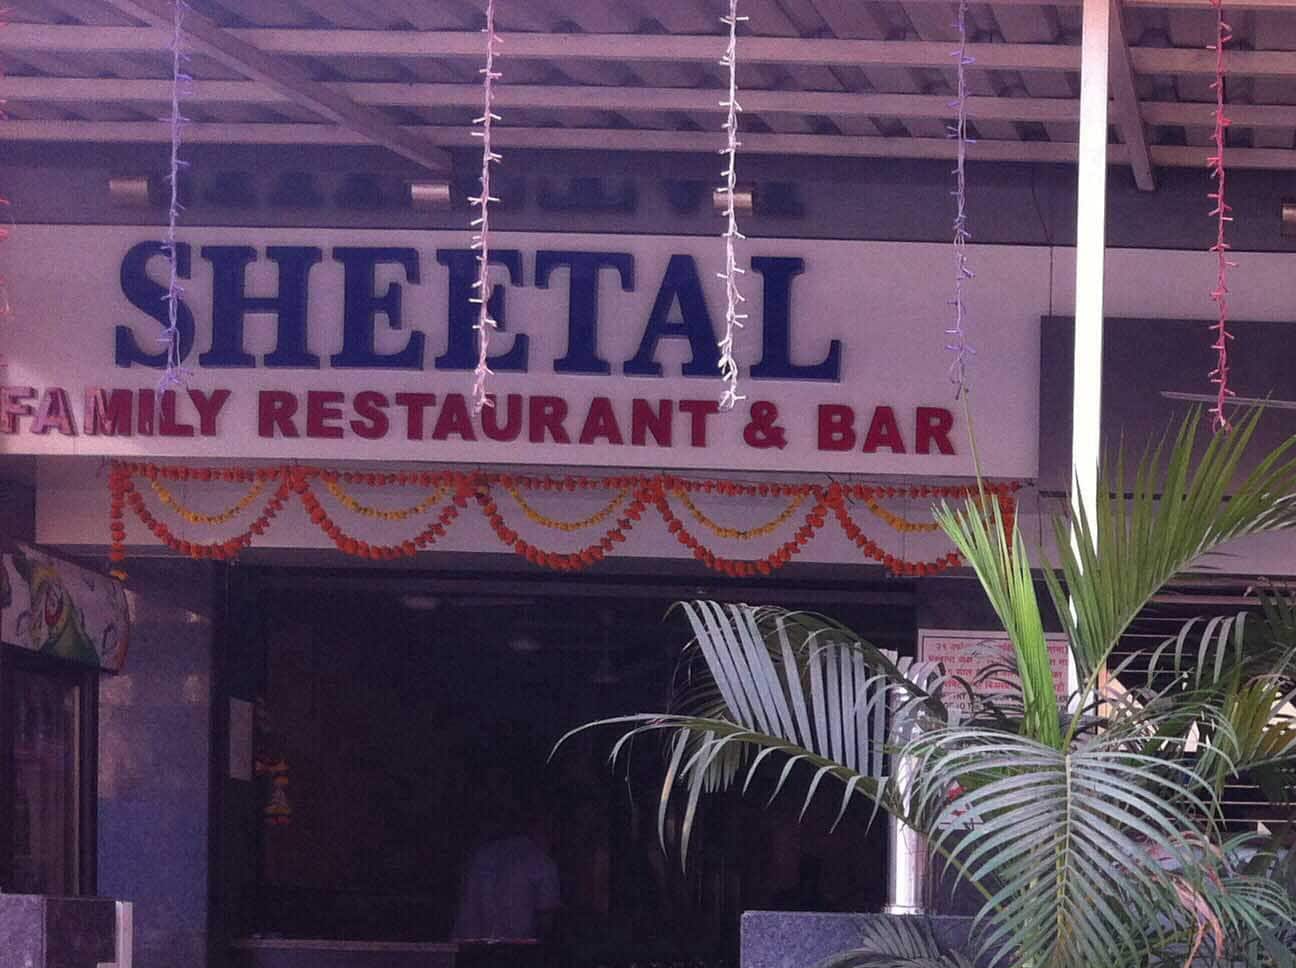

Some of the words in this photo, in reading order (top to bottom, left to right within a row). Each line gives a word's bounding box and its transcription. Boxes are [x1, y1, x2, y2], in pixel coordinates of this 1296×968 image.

[113, 239, 842, 382] SHEETAL
[0, 386, 232, 437] FAMILY
[258, 389, 720, 448] RESTAURANT
[742, 401, 788, 450] &
[817, 403, 959, 456] BAR
